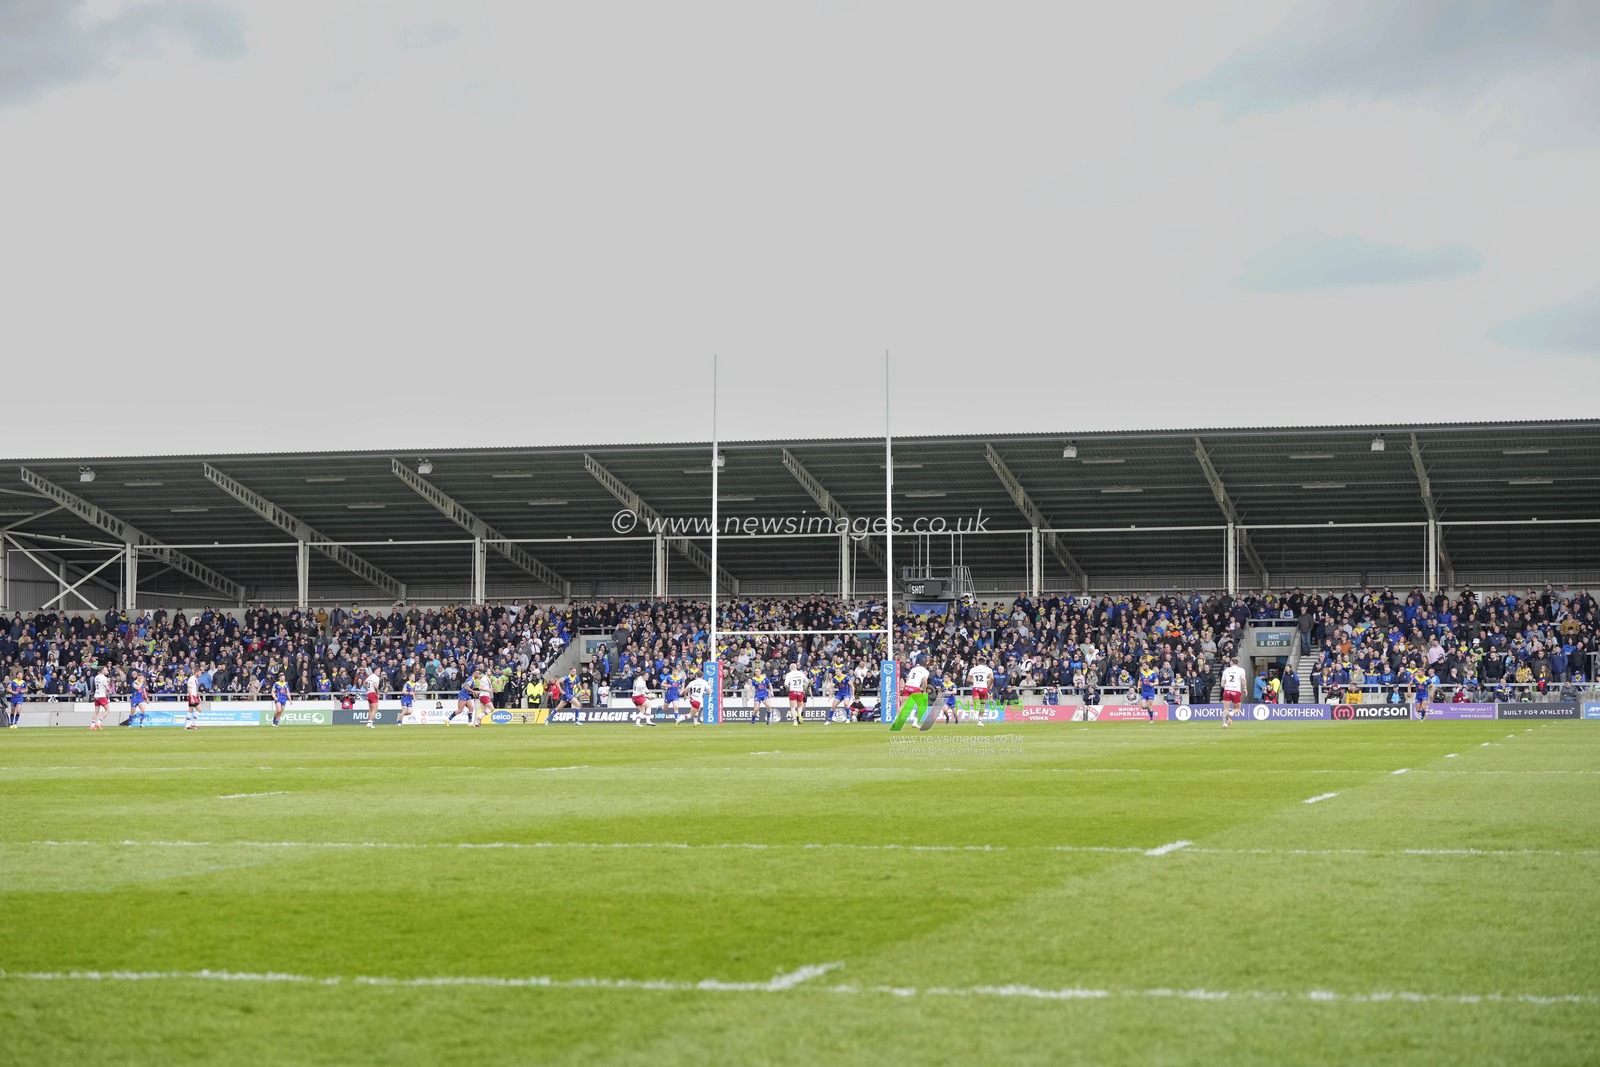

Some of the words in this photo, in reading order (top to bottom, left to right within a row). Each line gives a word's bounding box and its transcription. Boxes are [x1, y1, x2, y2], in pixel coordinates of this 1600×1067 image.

[912, 585, 924, 594] SHOT
[1230, 674, 1234, 682] 2
[266, 712, 311, 720] LVELLE
[353, 712, 382, 720] MUe
[492, 712, 511, 720] selco
[1022, 708, 1056, 717] GLEN'S
[1273, 708, 1324, 717] NORTHERN
[1356, 707, 1408, 717] morson
[588, 712, 628, 722] LEAGUE
